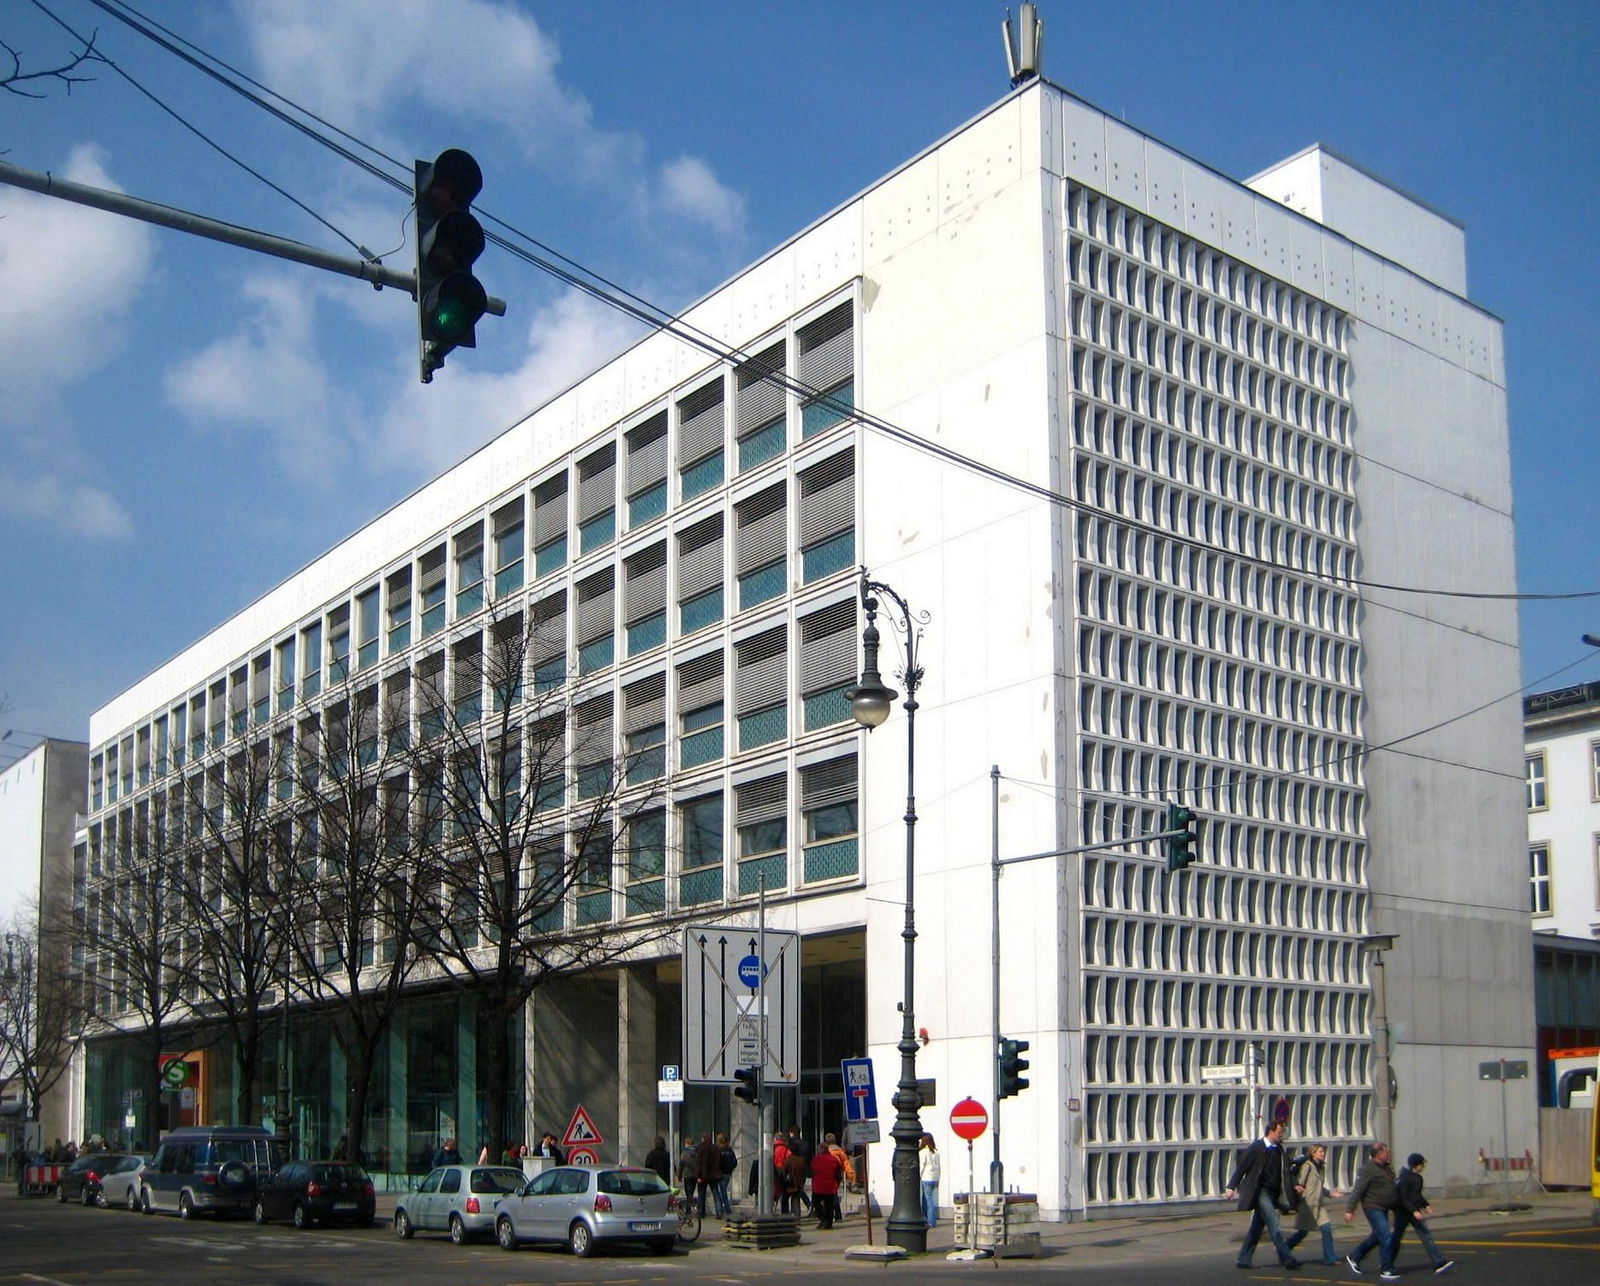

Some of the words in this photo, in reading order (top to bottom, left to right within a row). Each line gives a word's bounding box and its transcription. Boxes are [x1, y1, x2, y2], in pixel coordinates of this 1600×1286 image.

[167, 1062, 184, 1080] S
[666, 1067, 675, 1079] P
[575, 1155, 592, 1164] 30
